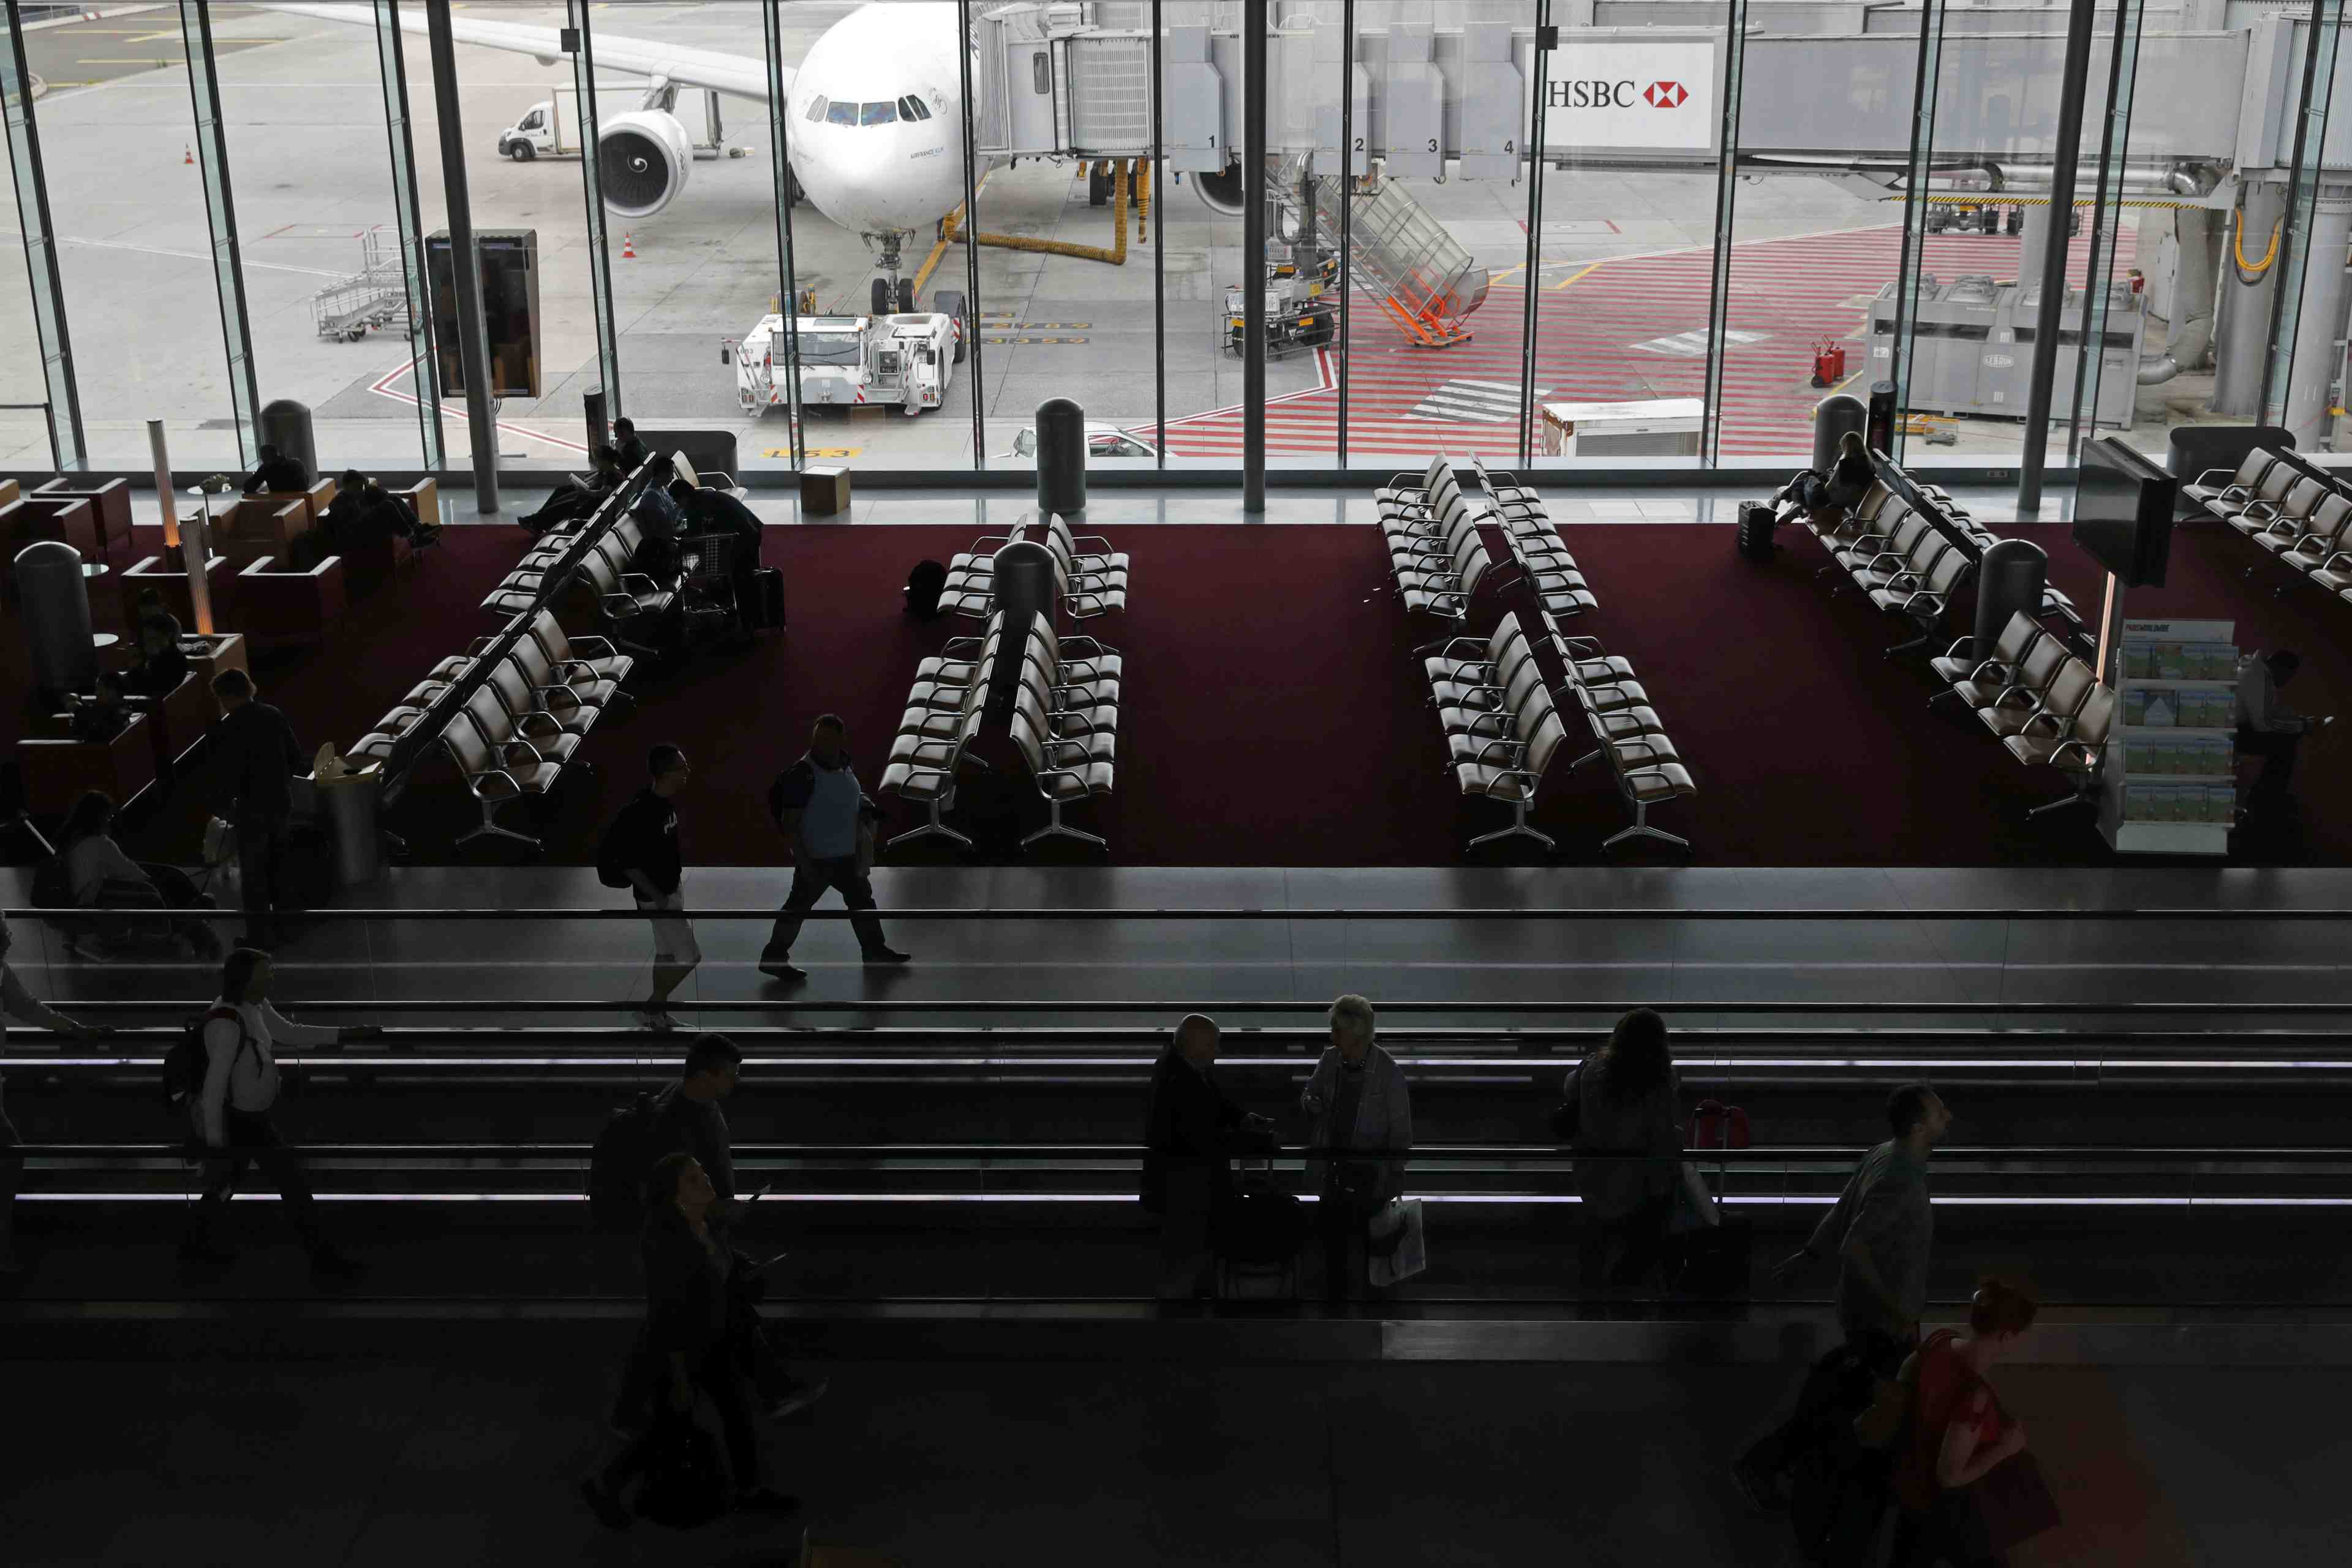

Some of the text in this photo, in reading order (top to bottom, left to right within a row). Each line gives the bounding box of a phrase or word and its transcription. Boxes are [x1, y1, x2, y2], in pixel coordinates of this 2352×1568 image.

[1547, 80, 1635, 108] HSBC
[1208, 135, 1215, 148] 1
[1355, 138, 1364, 152] 2
[1428, 138, 1438, 153] 3
[1504, 140, 1513, 154] 4
